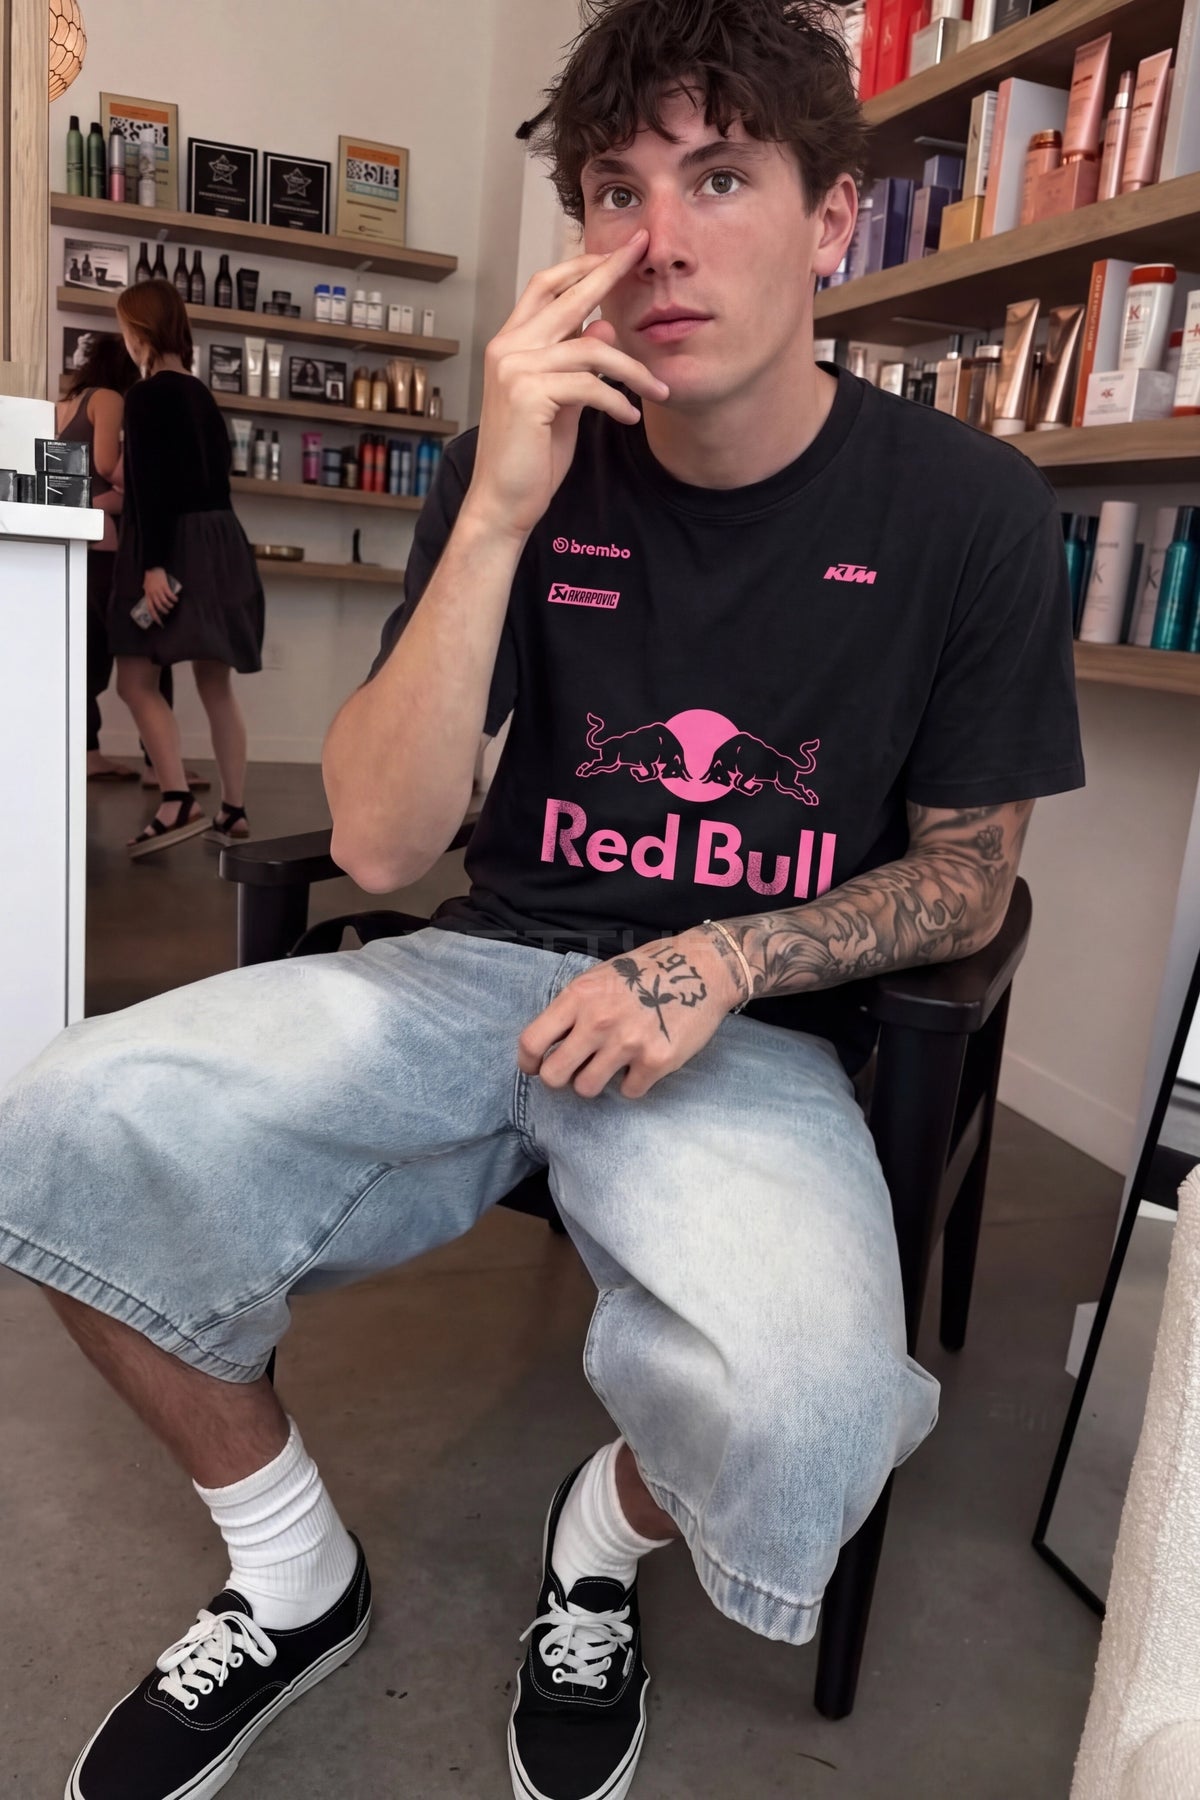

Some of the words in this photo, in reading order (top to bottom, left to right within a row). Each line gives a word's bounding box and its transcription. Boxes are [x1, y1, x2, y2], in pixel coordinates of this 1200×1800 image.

[570, 539, 630, 559] brembo
[823, 563, 878, 584] KTM
[567, 589, 617, 606] AKRAPOVIC
[540, 798, 681, 881] Red
[693, 819, 837, 899] Bull
[648, 945, 707, 1008] 1973
